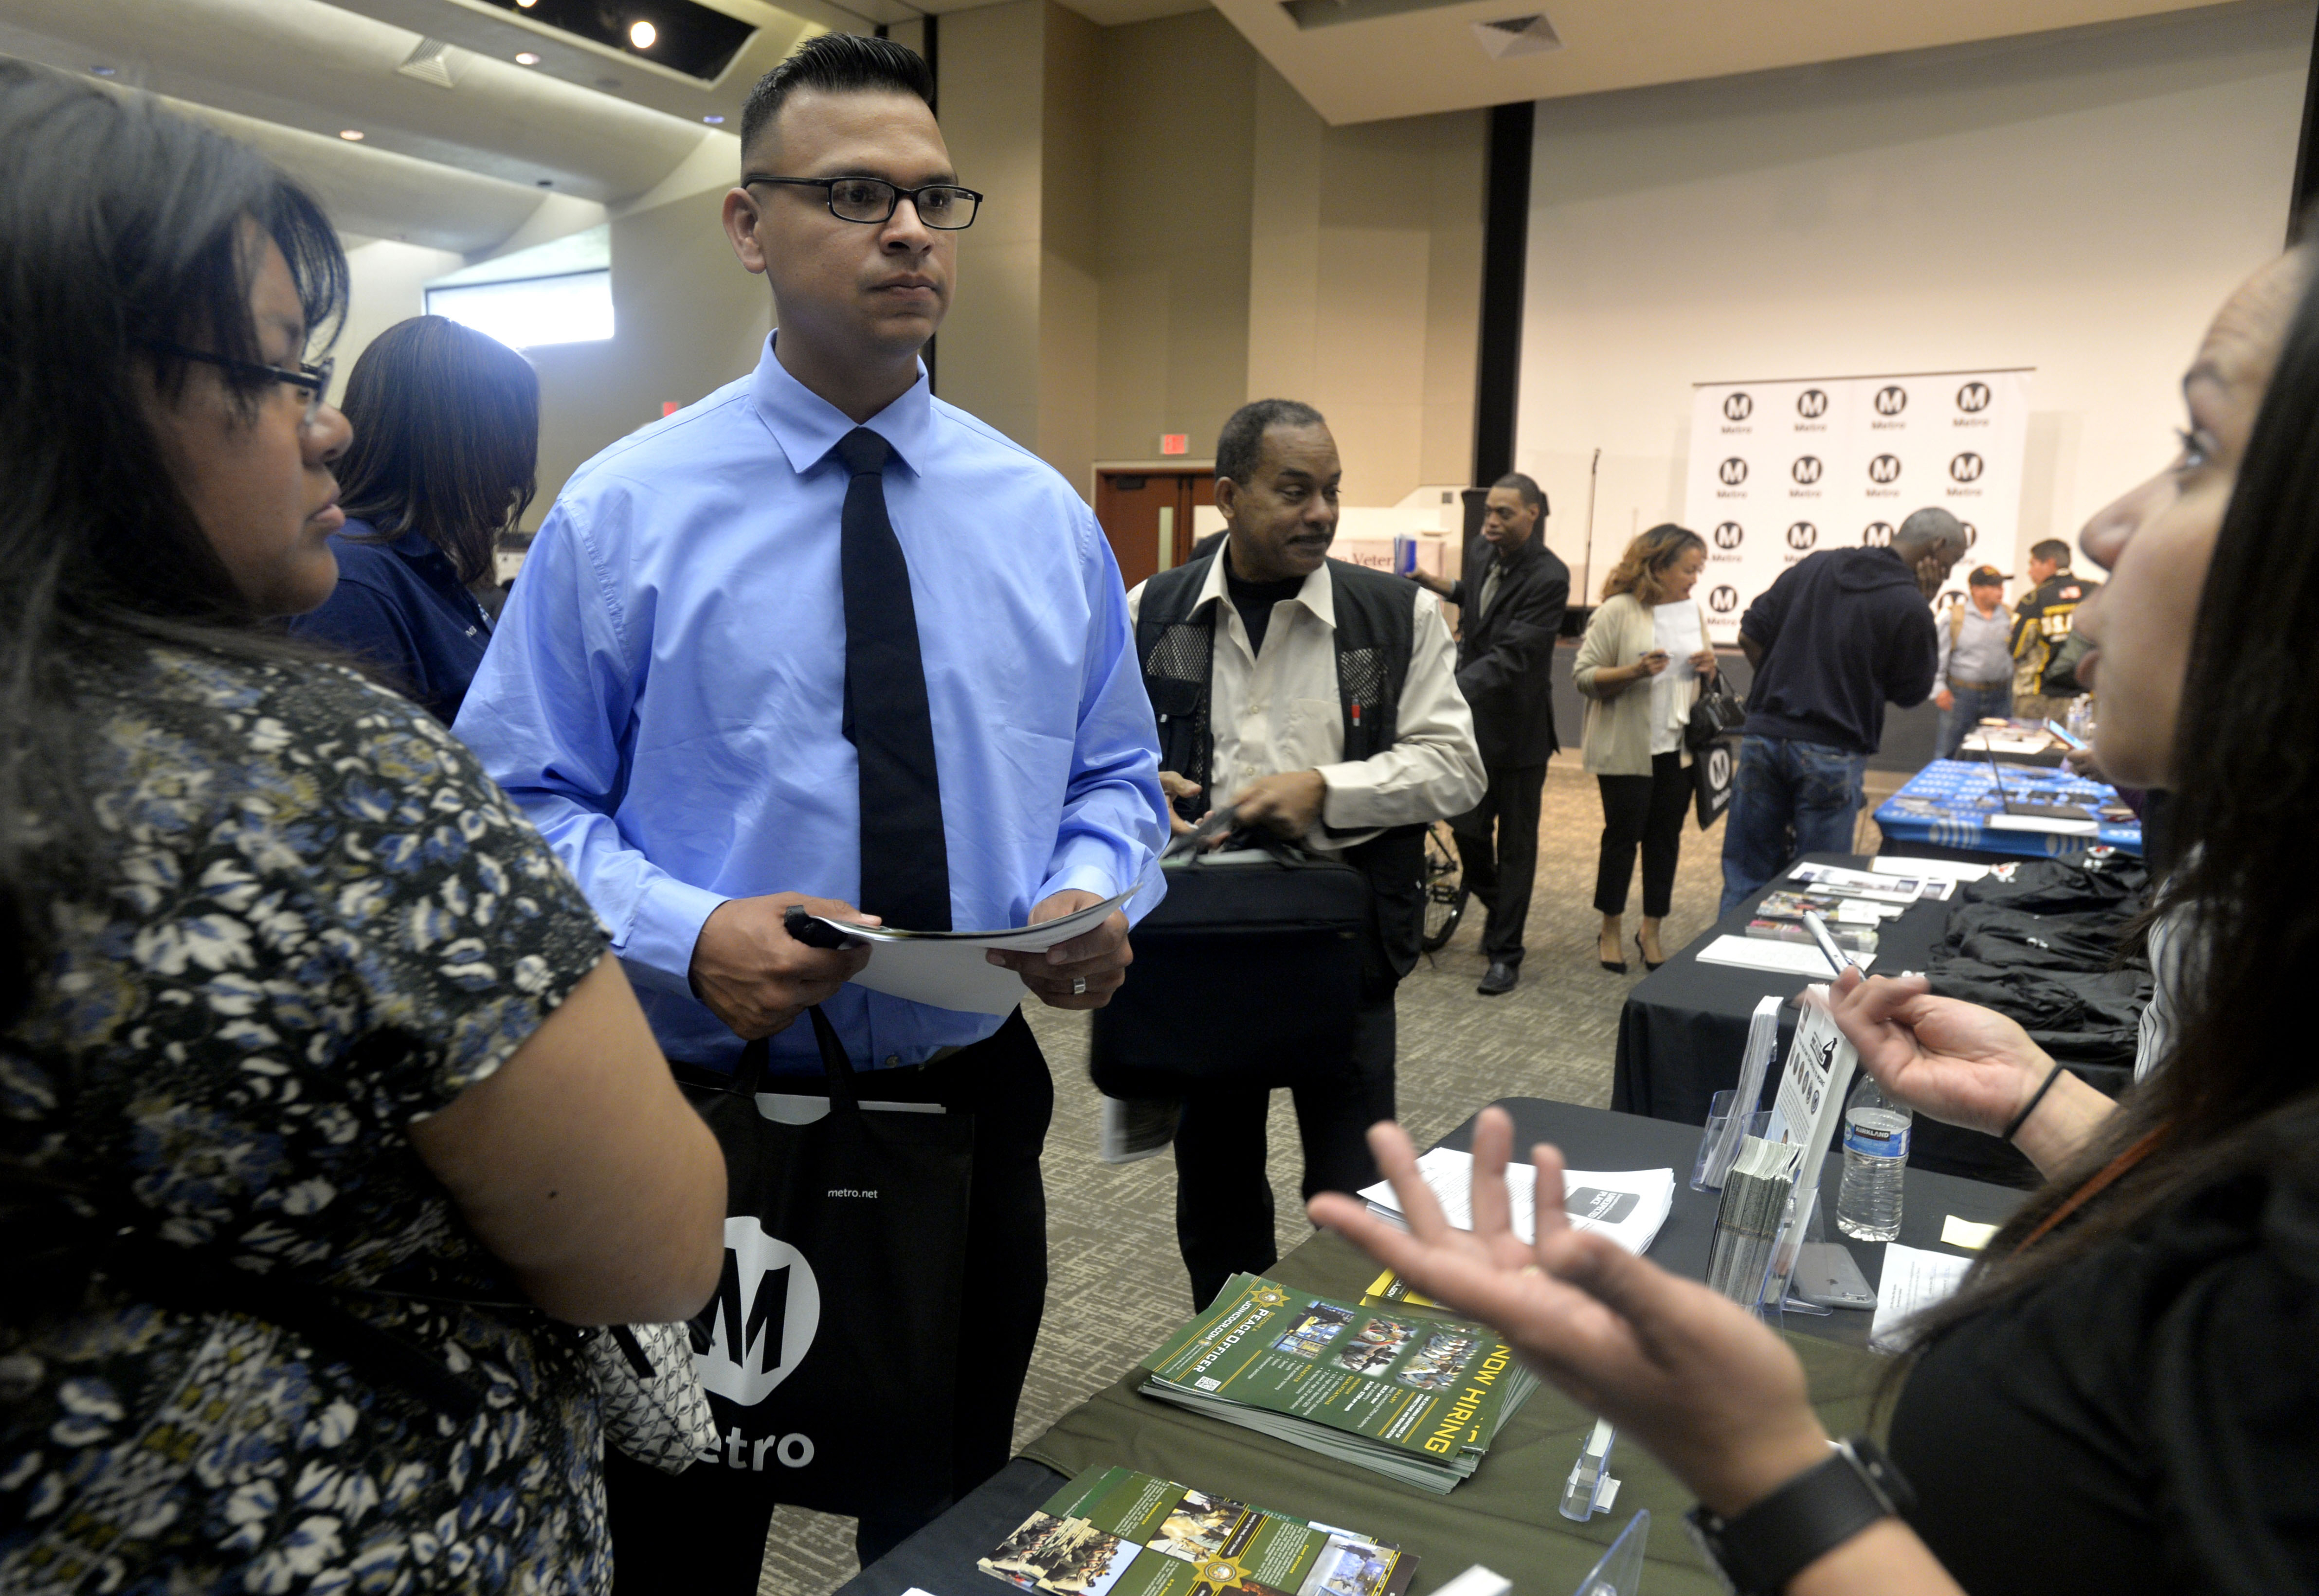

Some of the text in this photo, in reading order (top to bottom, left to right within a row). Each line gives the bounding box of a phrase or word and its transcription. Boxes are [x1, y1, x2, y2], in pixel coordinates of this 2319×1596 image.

[1726, 395, 1750, 419] M
[1800, 392, 1825, 416] M
[1877, 389, 1904, 414] M
[1960, 385, 1988, 410] M
[1722, 460, 1746, 483] M
[1795, 458, 1819, 482] M
[1871, 457, 1898, 481] M
[1953, 455, 1980, 480] M
[1717, 524, 1741, 547] M
[1790, 525, 1814, 547] M
[1712, 588, 1735, 610] M
[1855, 1126, 1890, 1138] KIRKLAND
[827, 1188, 878, 1199] metro.net
[1205, 1301, 1251, 1340] JOINCDCR.COM
[1254, 1312, 1275, 1328] BECOME
[1193, 1308, 1269, 1372] PEACE OFFICER
[1293, 1365, 1312, 1382] BENEFITS
[1325, 1376, 1353, 1404] QUALIFICATIONS
[1345, 1378, 1361, 1394] MINIMUM
[1389, 1389, 1403, 1403] SALARY
[1407, 1394, 1423, 1411] CORRECTIONS
[1412, 1401, 1426, 1416] CALIFORNIA
[1424, 1345, 1512, 1453] NOW HIRING
[1385, 1417, 1404, 1438] REHABILITATION
[1398, 1416, 1414, 1433] DEPARTMENT
[697, 1426, 815, 1471] tro
